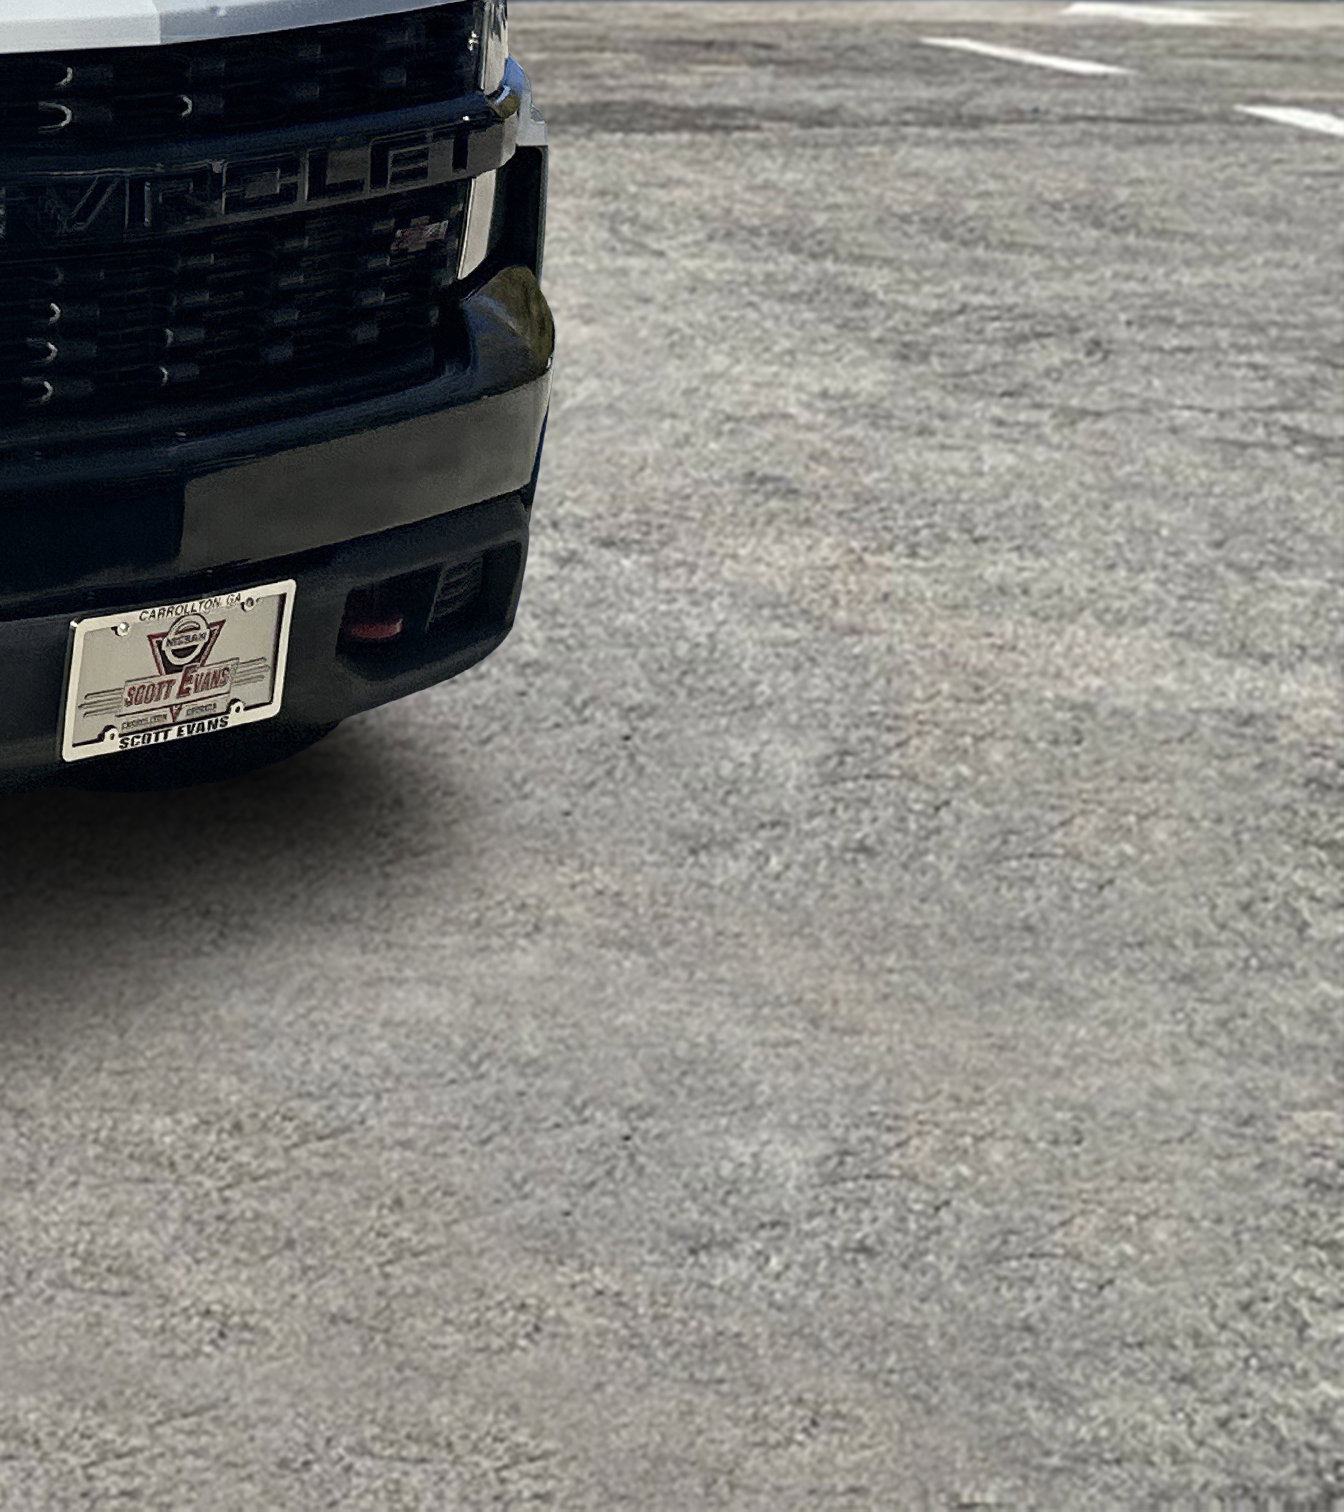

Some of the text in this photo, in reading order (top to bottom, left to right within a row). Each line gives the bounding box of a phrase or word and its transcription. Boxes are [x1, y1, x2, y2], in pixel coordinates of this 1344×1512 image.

[124, 664, 230, 707] SCOTT EVANS
[119, 716, 230, 750] SCOTT EVANS
